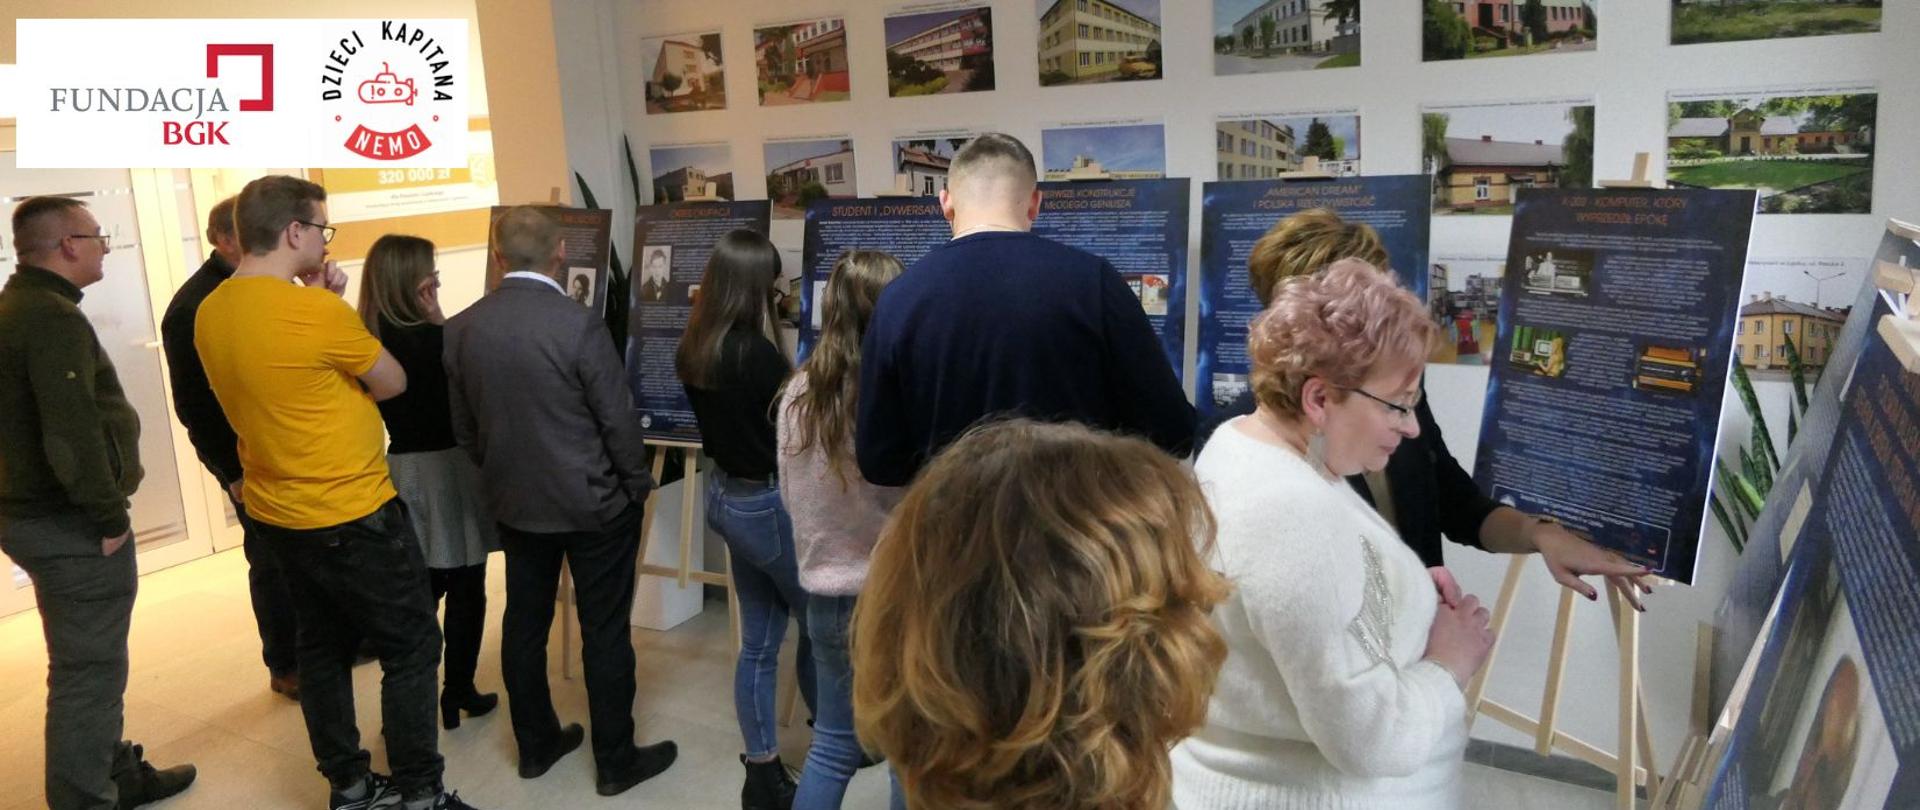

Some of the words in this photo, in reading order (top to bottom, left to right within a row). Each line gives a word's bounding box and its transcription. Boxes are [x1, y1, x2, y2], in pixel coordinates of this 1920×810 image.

[378, 170, 404, 185] 320
[408, 168, 434, 182] 000
[1041, 189, 1074, 199] IERWSZE
[1044, 199, 1089, 210] MŁODEGO
[1090, 198, 1132, 209] GENIUSZA
[832, 206, 872, 217] STUDENT
